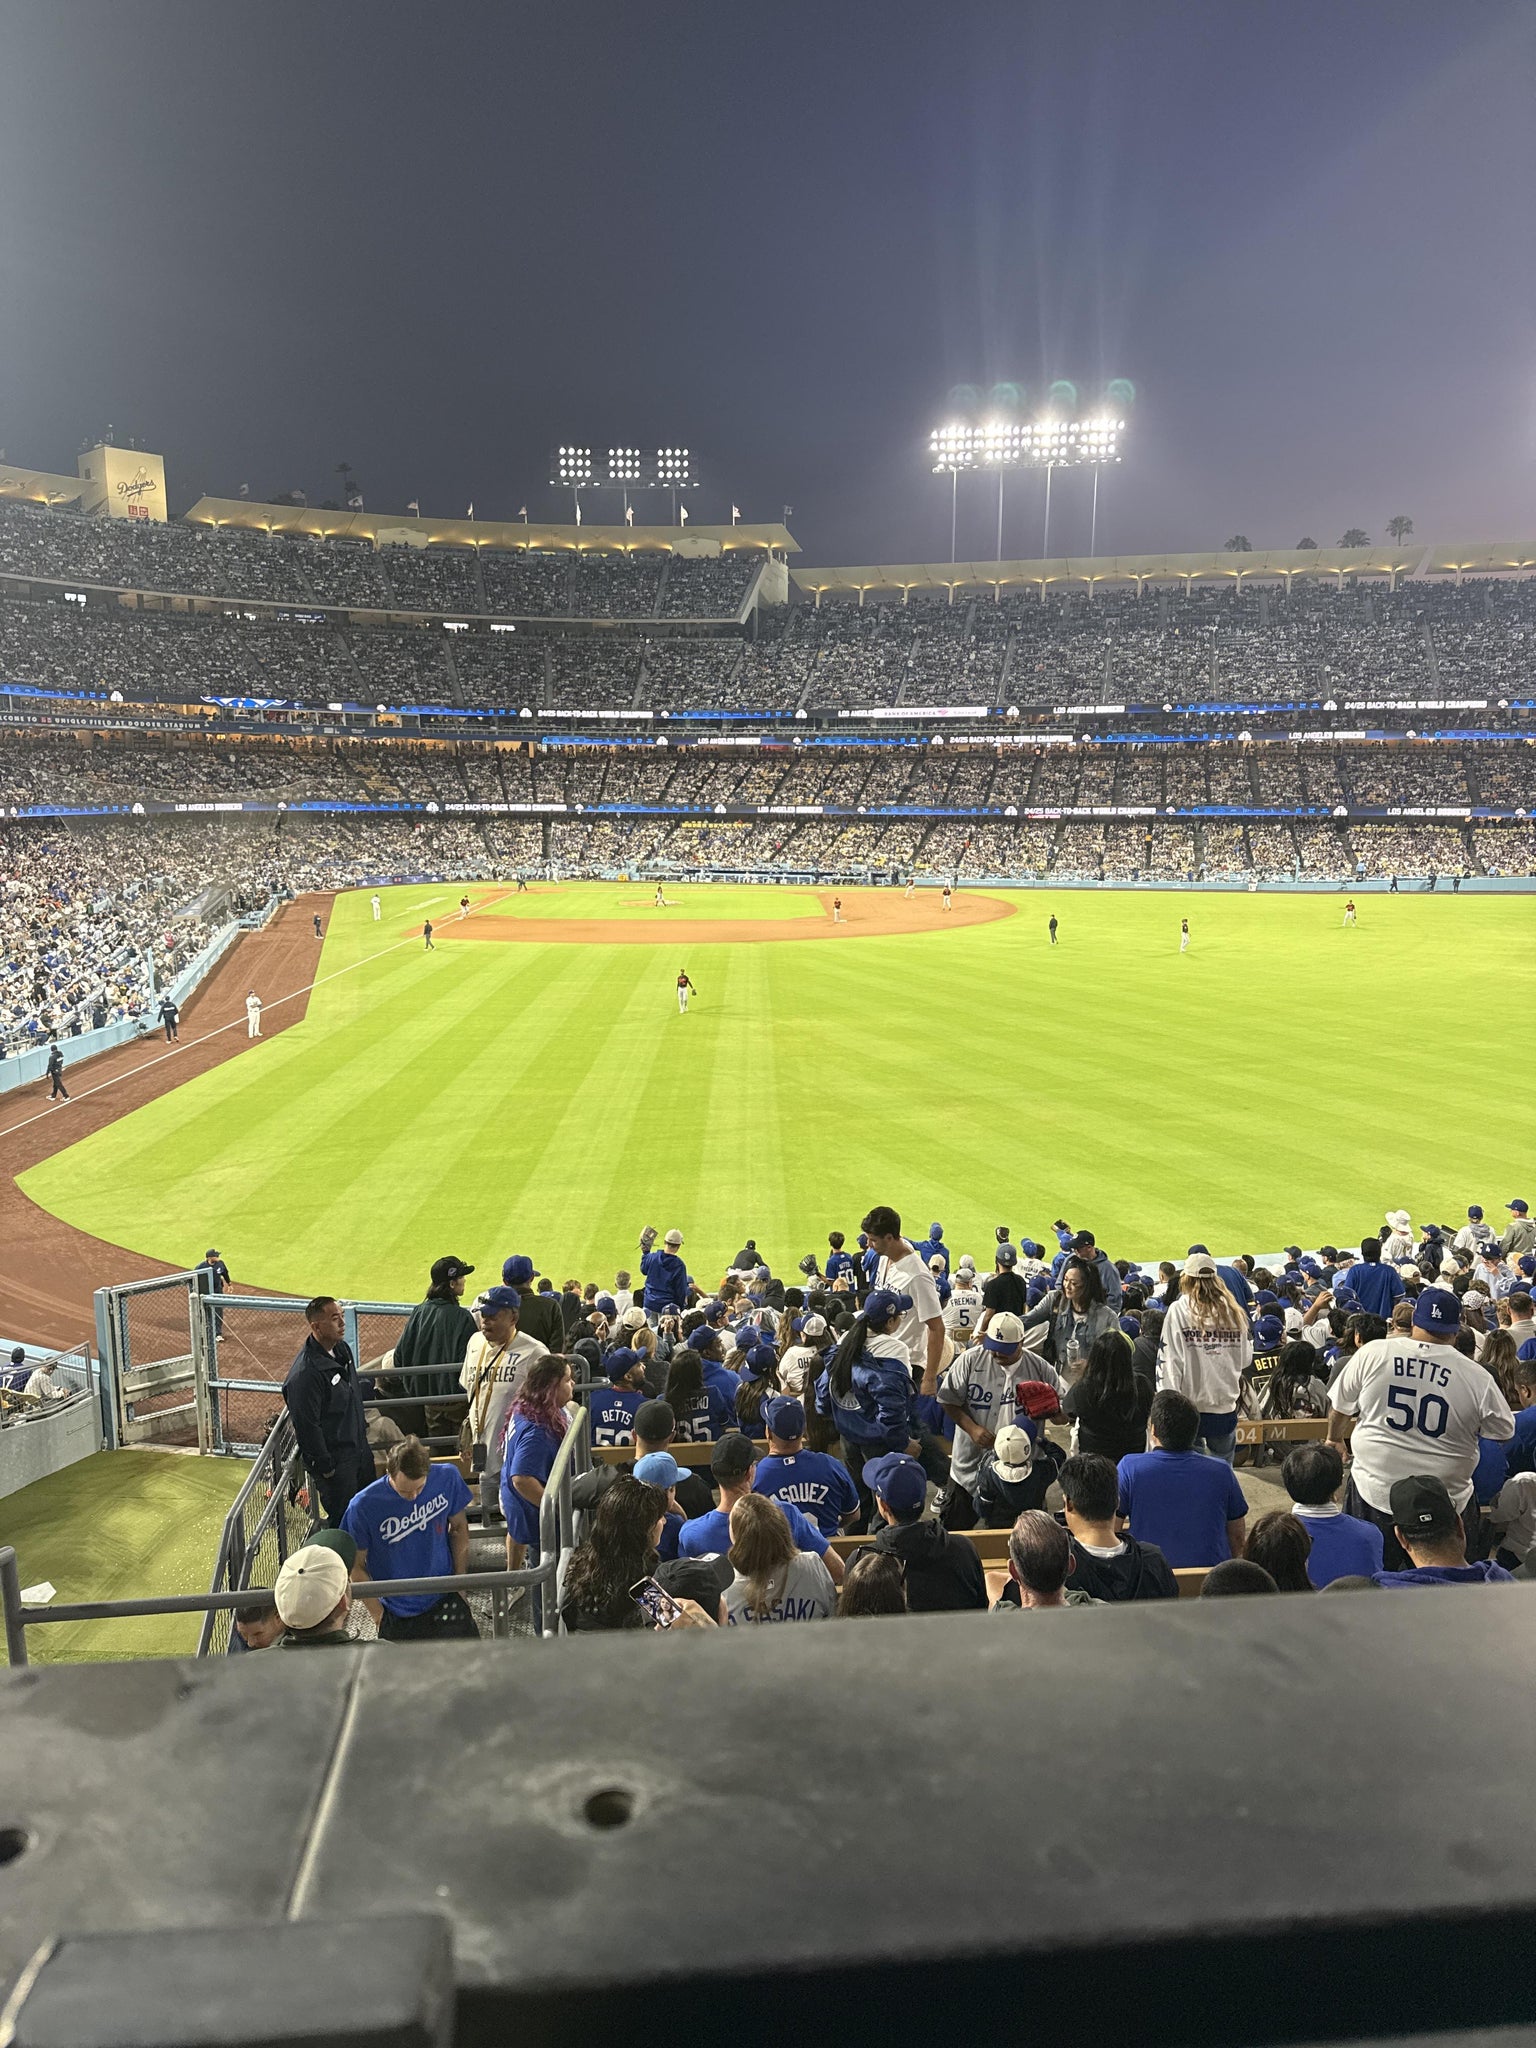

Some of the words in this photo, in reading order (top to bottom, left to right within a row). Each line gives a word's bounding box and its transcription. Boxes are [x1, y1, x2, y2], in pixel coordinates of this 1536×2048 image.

[117, 479, 157, 497] Dodgers
[951, 1297, 977, 1307] FREEMAN
[959, 1309, 970, 1327] 5
[1431, 1303, 1442, 1319] LA
[1183, 1330, 1213, 1338] WORD
[508, 1352, 521, 1365] 17
[797, 1356, 811, 1369] OH
[1254, 1356, 1281, 1371] BETT
[1393, 1356, 1452, 1388] BETTS
[601, 1409, 633, 1425] BETTS
[1385, 1384, 1450, 1438] 50
[595, 1427, 635, 1446] 50
[1270, 1427, 1287, 1440] M
[379, 1493, 449, 1544] Dodgers
